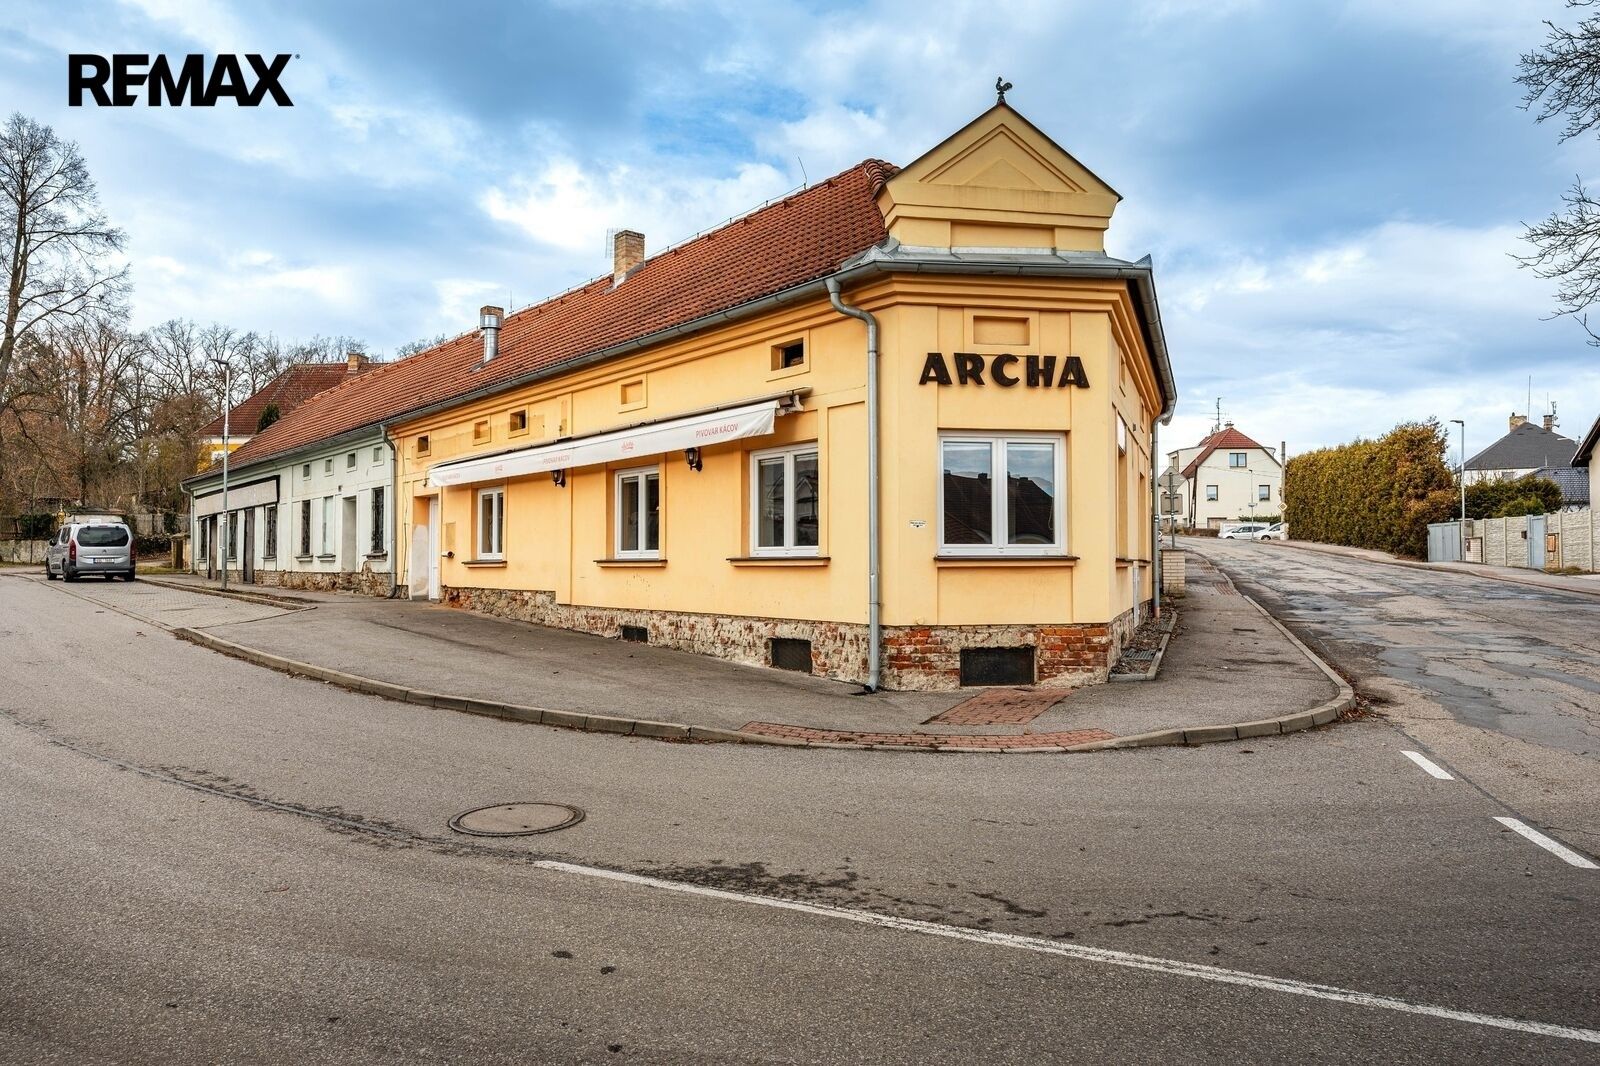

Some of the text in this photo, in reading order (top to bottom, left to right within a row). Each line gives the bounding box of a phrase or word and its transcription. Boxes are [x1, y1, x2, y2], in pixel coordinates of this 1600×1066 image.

[919, 352, 1090, 389] ARCHA
[695, 423, 738, 438] PIVOVAR KÁCOV
